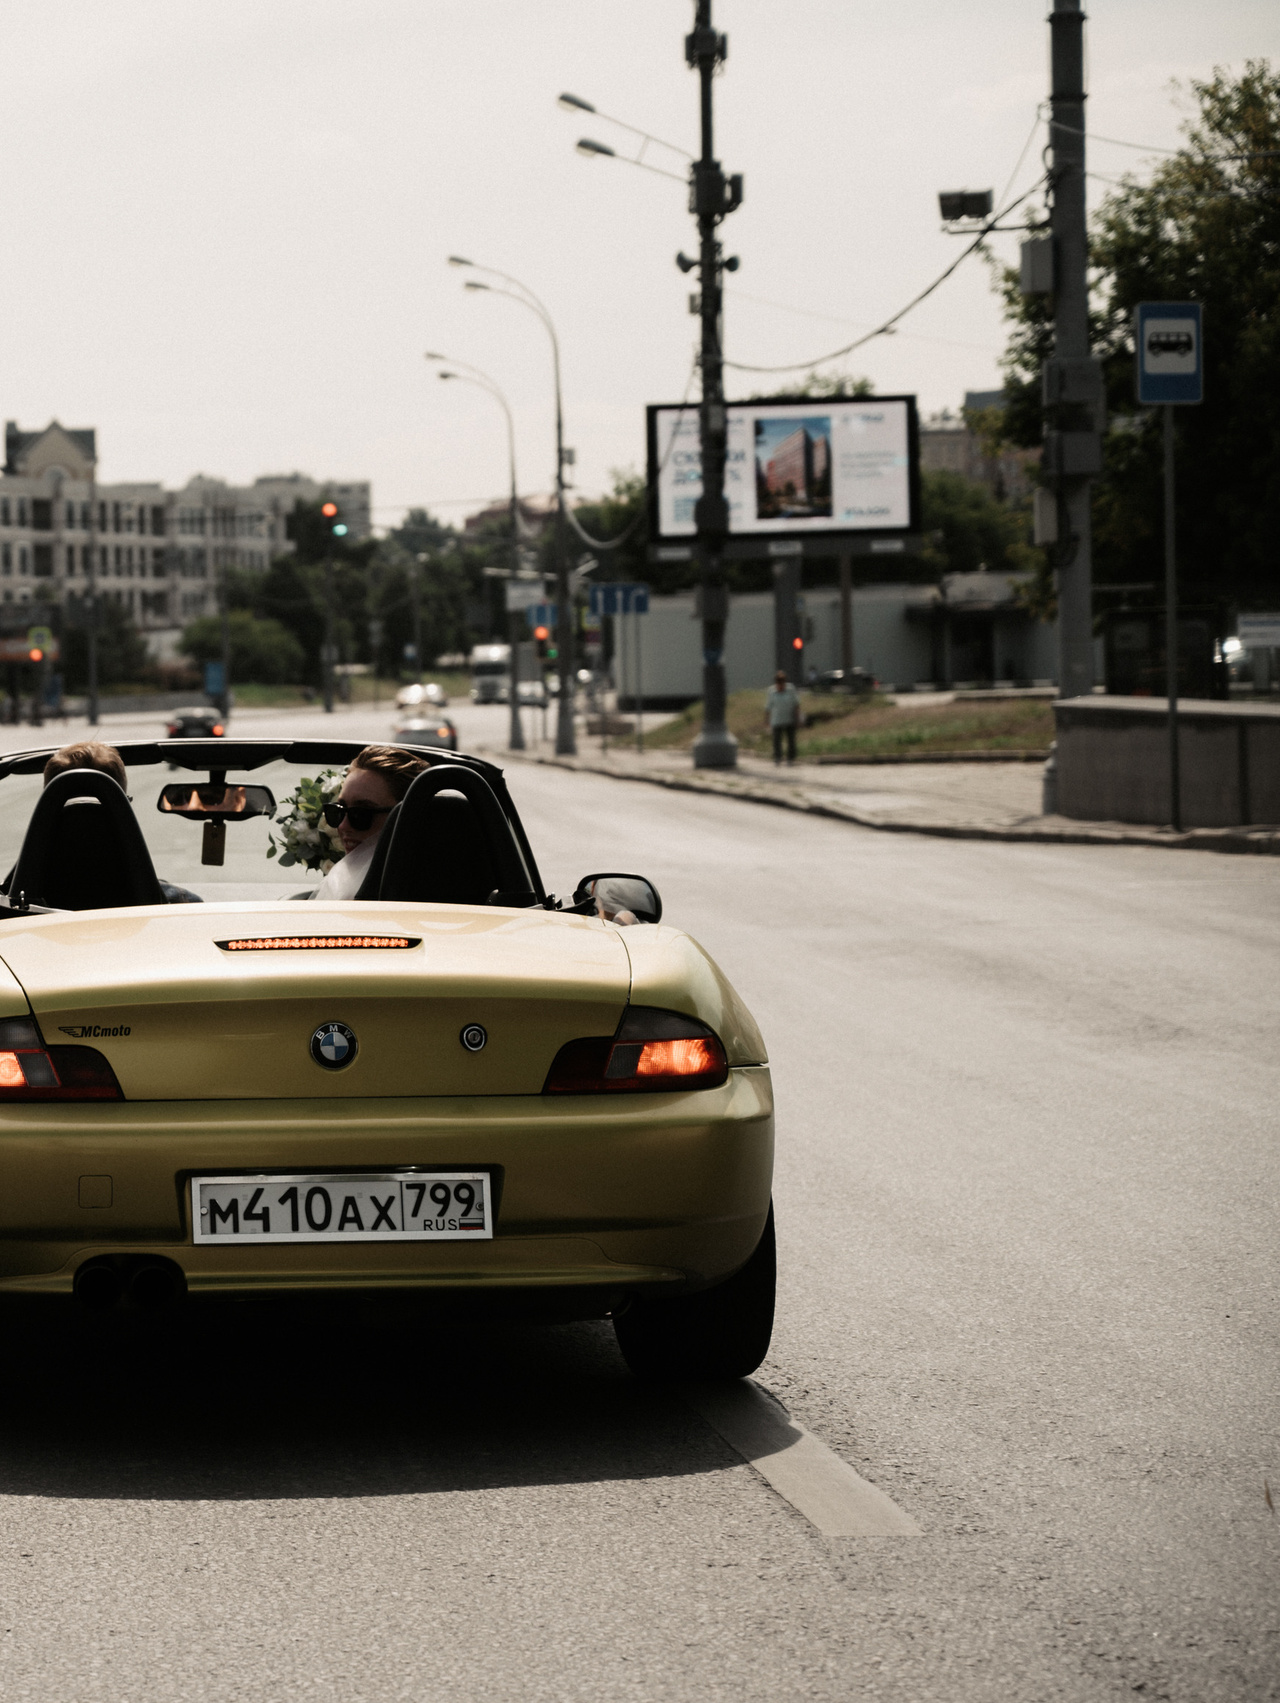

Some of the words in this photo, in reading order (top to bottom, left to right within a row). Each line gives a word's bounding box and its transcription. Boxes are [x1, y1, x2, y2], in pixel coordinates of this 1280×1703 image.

[81, 1024, 131, 1038] MCmoto
[315, 1024, 353, 1040] BMW
[405, 1182, 475, 1218] 799
[423, 1218, 458, 1231] RUS
